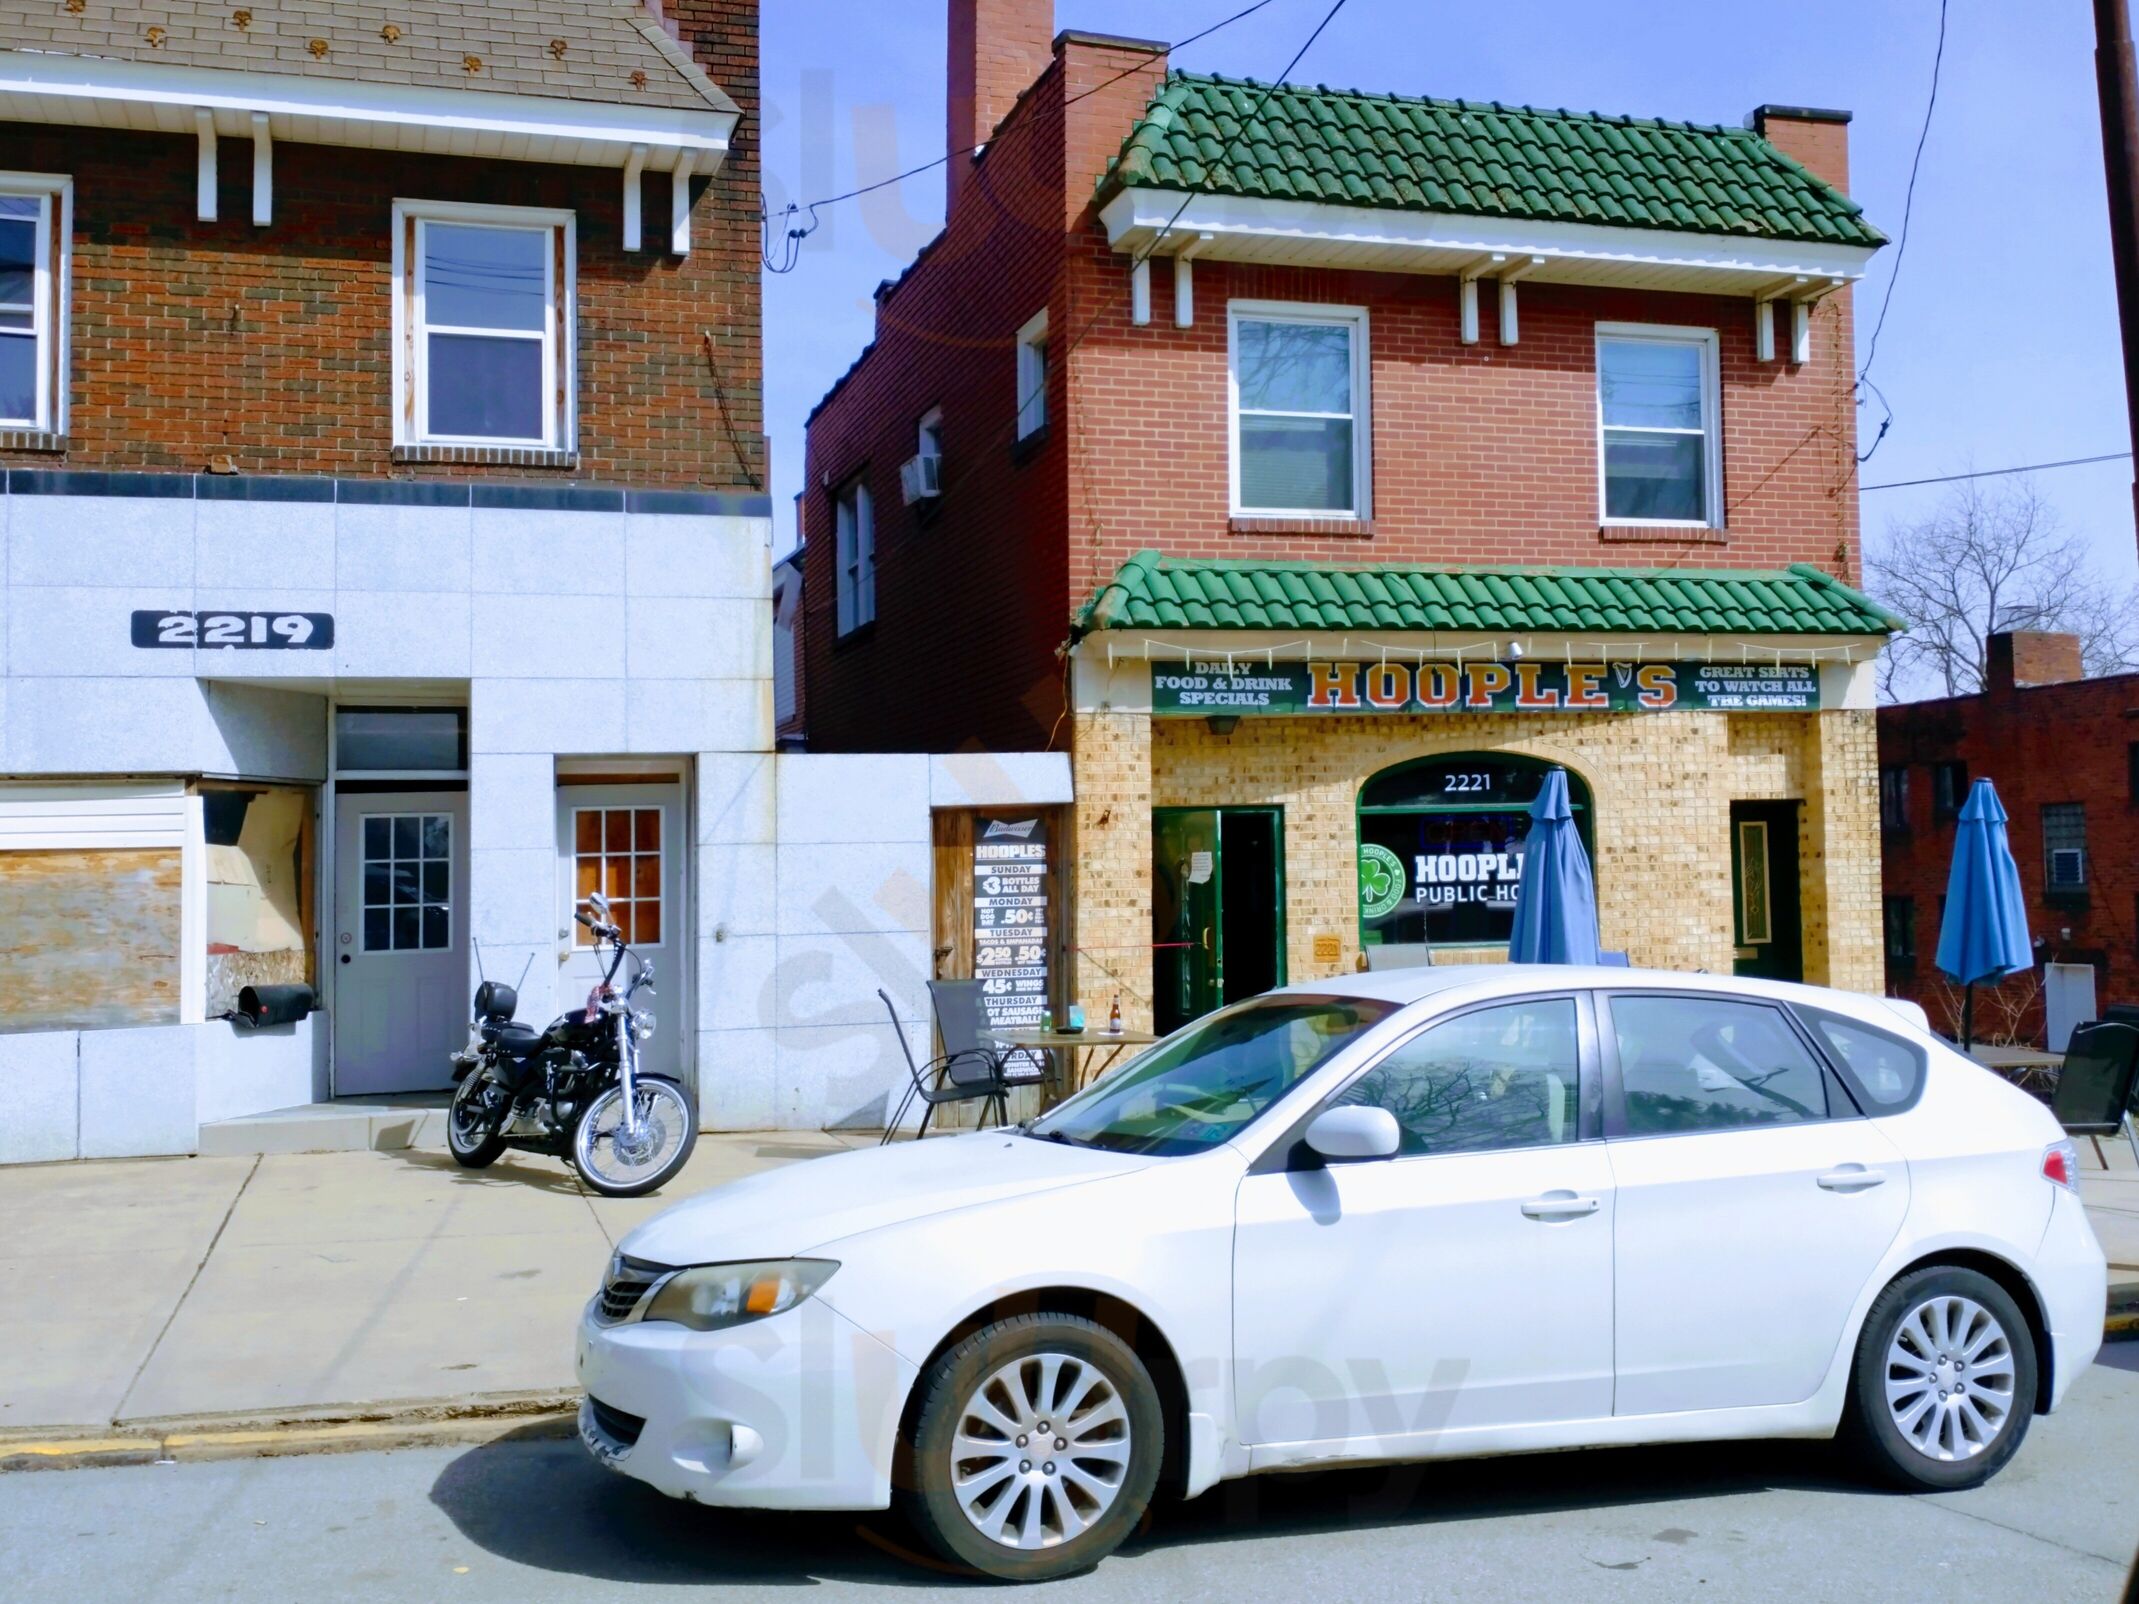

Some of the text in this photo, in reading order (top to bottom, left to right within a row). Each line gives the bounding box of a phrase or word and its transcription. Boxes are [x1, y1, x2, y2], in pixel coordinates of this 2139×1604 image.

[158, 615, 314, 643] 2219
[1195, 662, 1252, 674] DAILY
[1700, 666, 1810, 678] GREAT SEATS
[1155, 676, 1293, 691] FOOD & DRINK
[1306, 662, 1678, 708] HOOPLE'S
[1695, 680, 1817, 692] TO WATCH ALL
[1179, 691, 1270, 705] SPECIALS
[1707, 694, 1807, 707] THE GAMES!
[1444, 774, 1491, 791] 2221
[991, 866, 1032, 874] SUNDAY
[1002, 877, 1040, 885] BOTTLES
[1002, 884, 1040, 893] ALL DAY
[1416, 885, 1488, 903] PUBLIC
[989, 898, 1033, 906] MONDAY
[990, 929, 1033, 937] TUESDAY
[982, 969, 1041, 977] WEDNESDAY
[986, 997, 1037, 1005] THURSDAY
